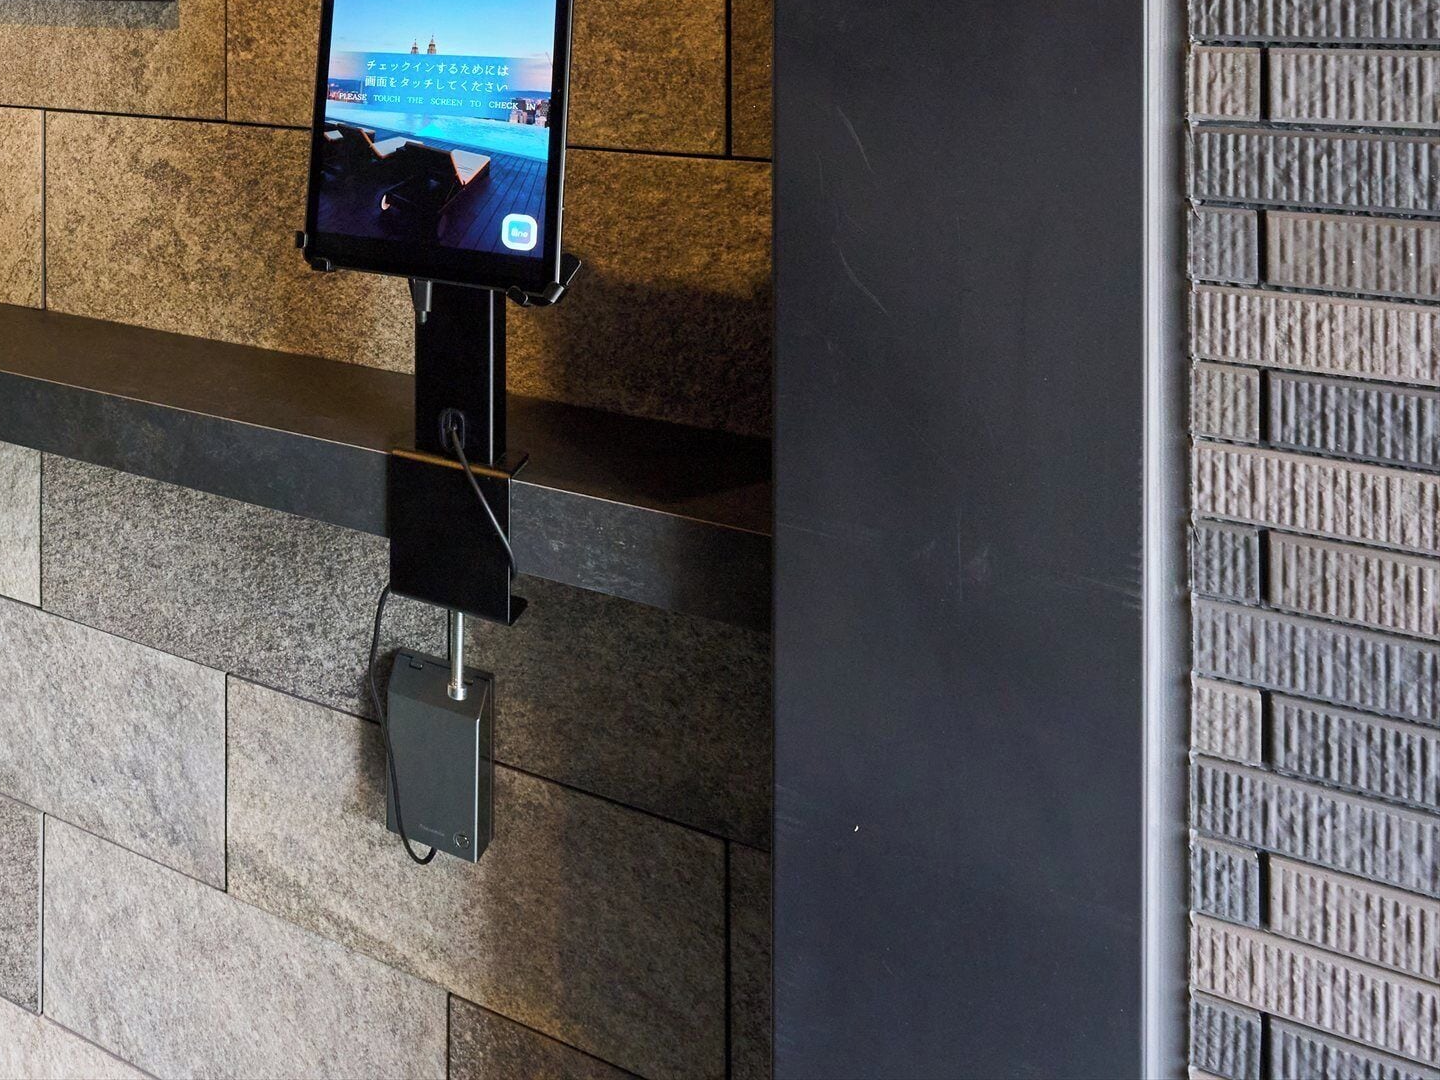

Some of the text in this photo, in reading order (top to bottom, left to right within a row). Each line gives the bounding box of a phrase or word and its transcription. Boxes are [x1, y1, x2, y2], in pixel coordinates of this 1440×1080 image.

[366, 59, 510, 77] チェックインするためには
[364, 75, 509, 93] 画面をタッチしてください
[338, 92, 536, 111] PLEASE TOUCH THE SCREEN TO CHECK IN
